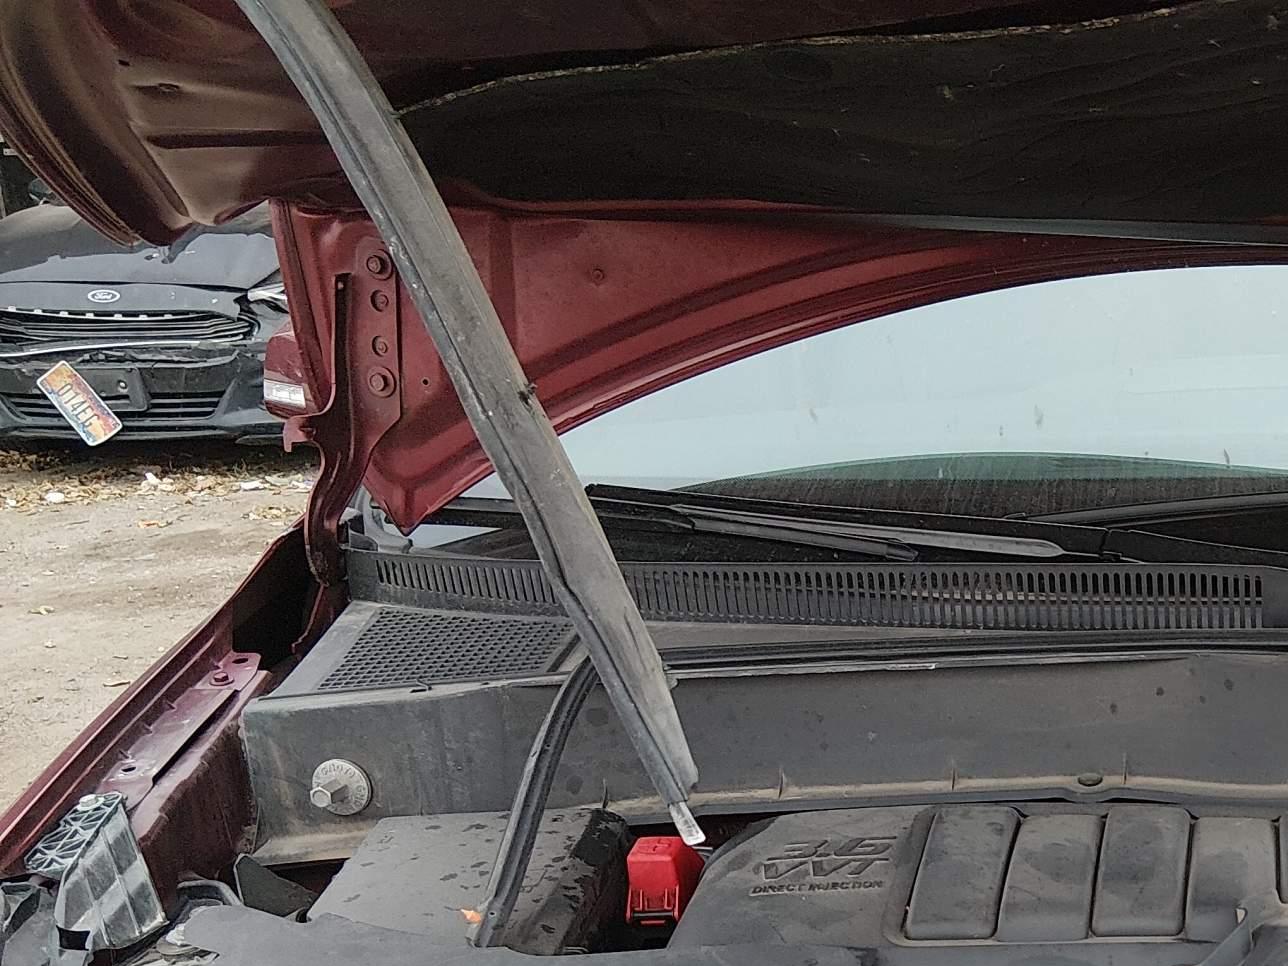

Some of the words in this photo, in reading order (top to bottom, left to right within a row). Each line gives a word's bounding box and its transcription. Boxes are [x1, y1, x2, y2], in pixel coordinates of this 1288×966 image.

[766, 836, 898, 861] 3.6
[763, 858, 890, 881] VVT
[750, 883, 806, 895] DIRECT
[807, 880, 884, 892] INJECTION
